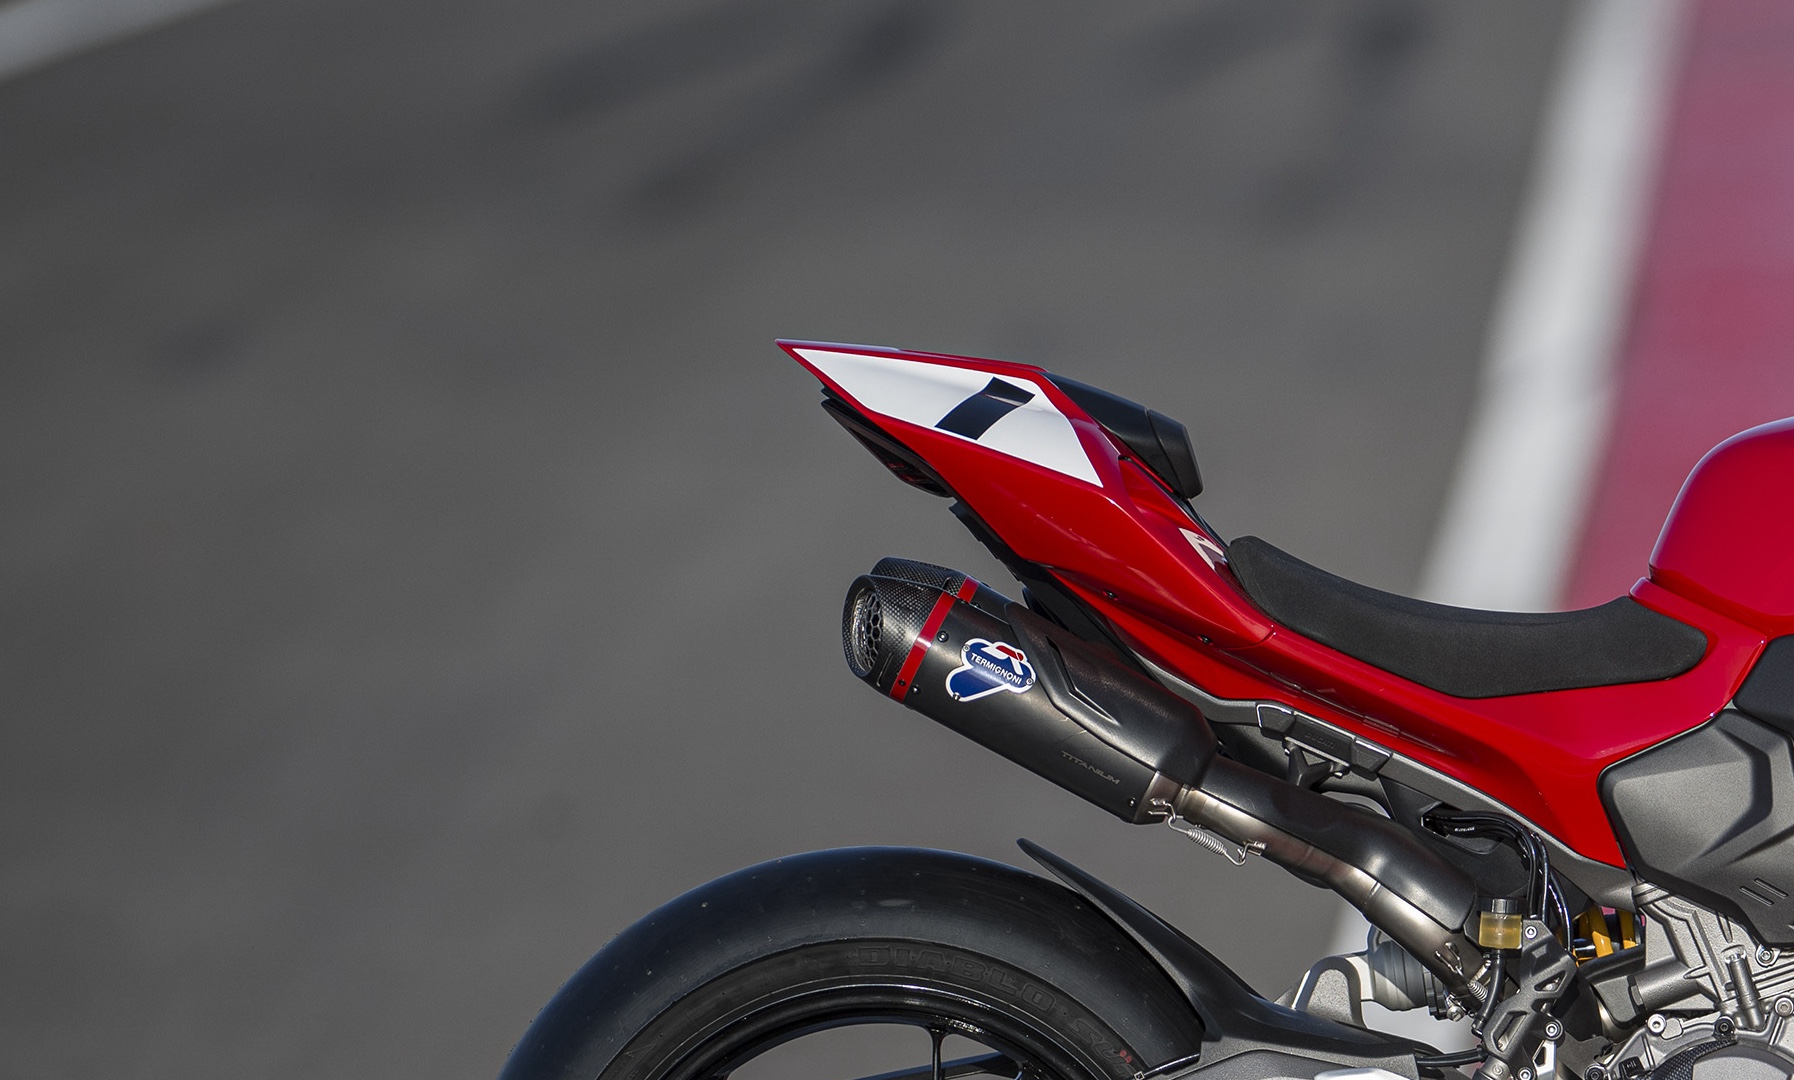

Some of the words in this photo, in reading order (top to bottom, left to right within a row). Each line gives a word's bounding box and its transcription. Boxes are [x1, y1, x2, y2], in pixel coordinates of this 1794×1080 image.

[970, 652, 1022, 685] TERMIGNONI
[1061, 750, 1120, 785] TITANIUM
[857, 945, 1057, 1012] DIABLO
